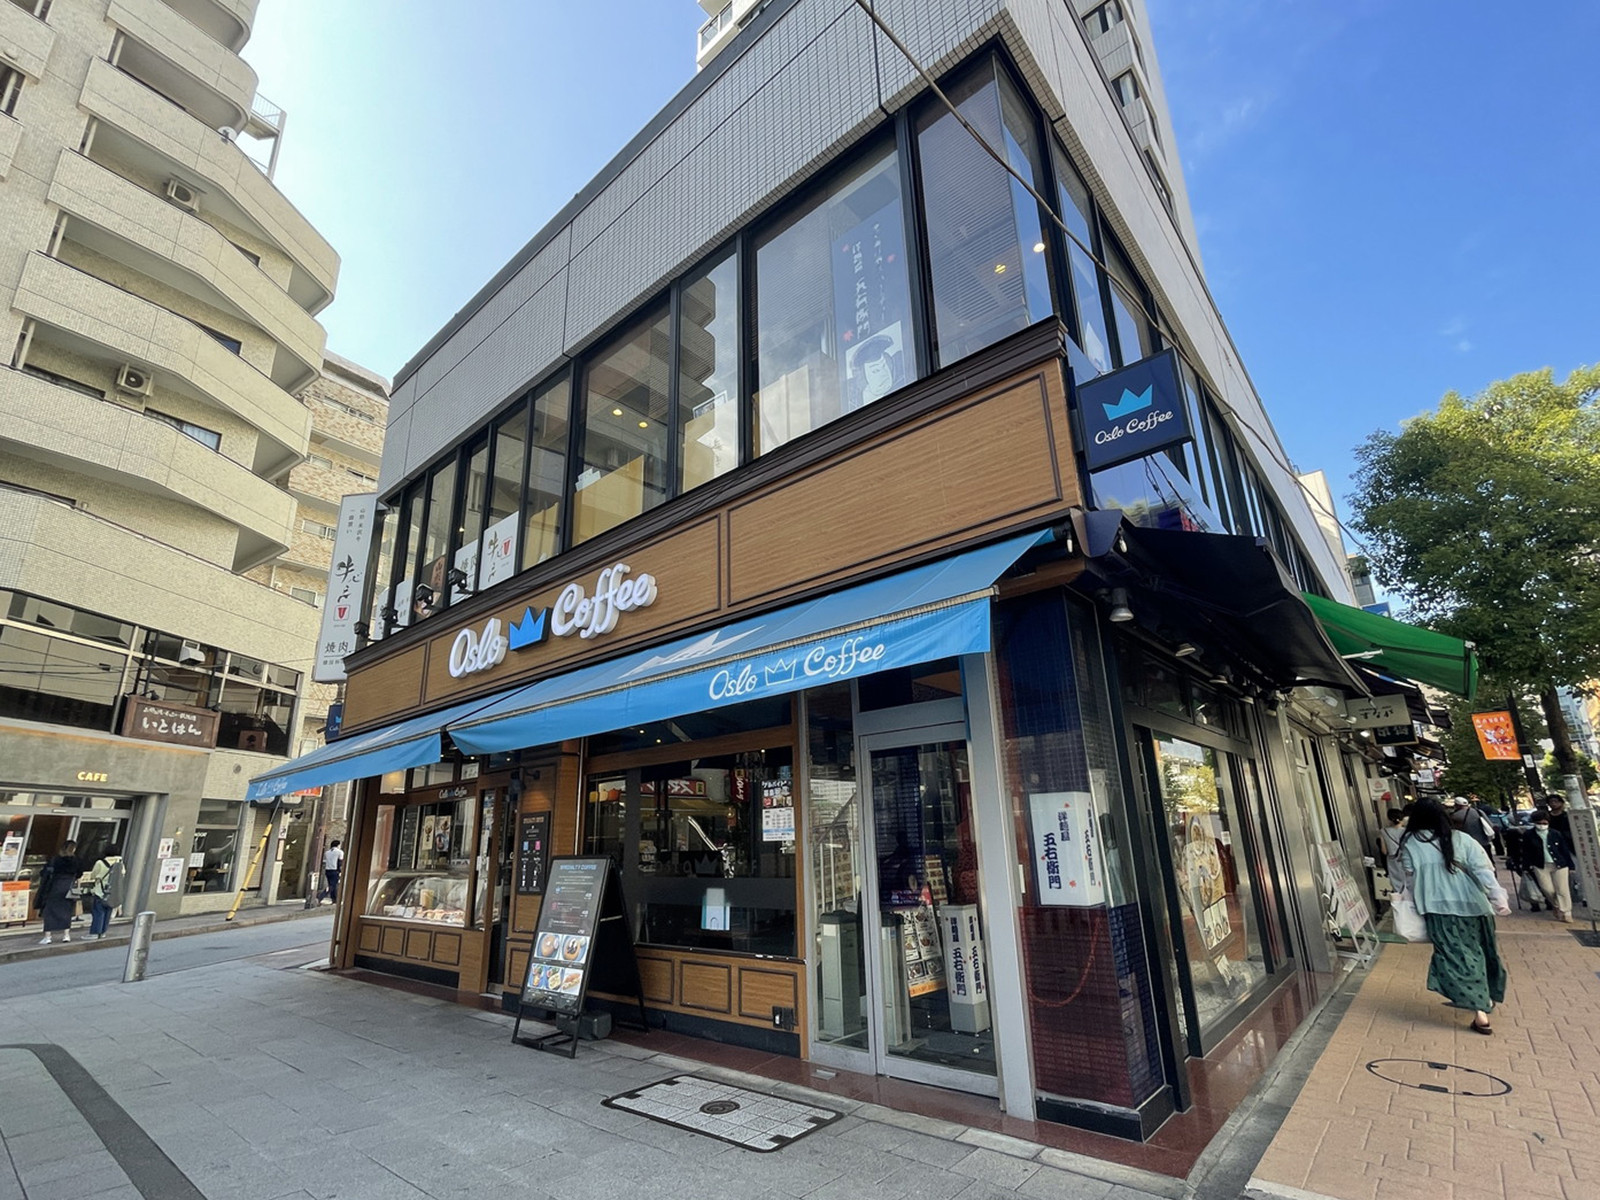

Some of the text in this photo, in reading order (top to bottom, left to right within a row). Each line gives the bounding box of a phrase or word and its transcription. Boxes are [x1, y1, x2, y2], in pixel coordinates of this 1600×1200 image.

[1094, 409, 1174, 446] Oslo Coffee
[448, 562, 659, 679] Oslo Coffee
[324, 640, 349, 654] 焼肉
[708, 636, 887, 701] Oslo Coffee
[77, 771, 108, 782] CAFE
[1043, 832, 1062, 890] 五右衛門
